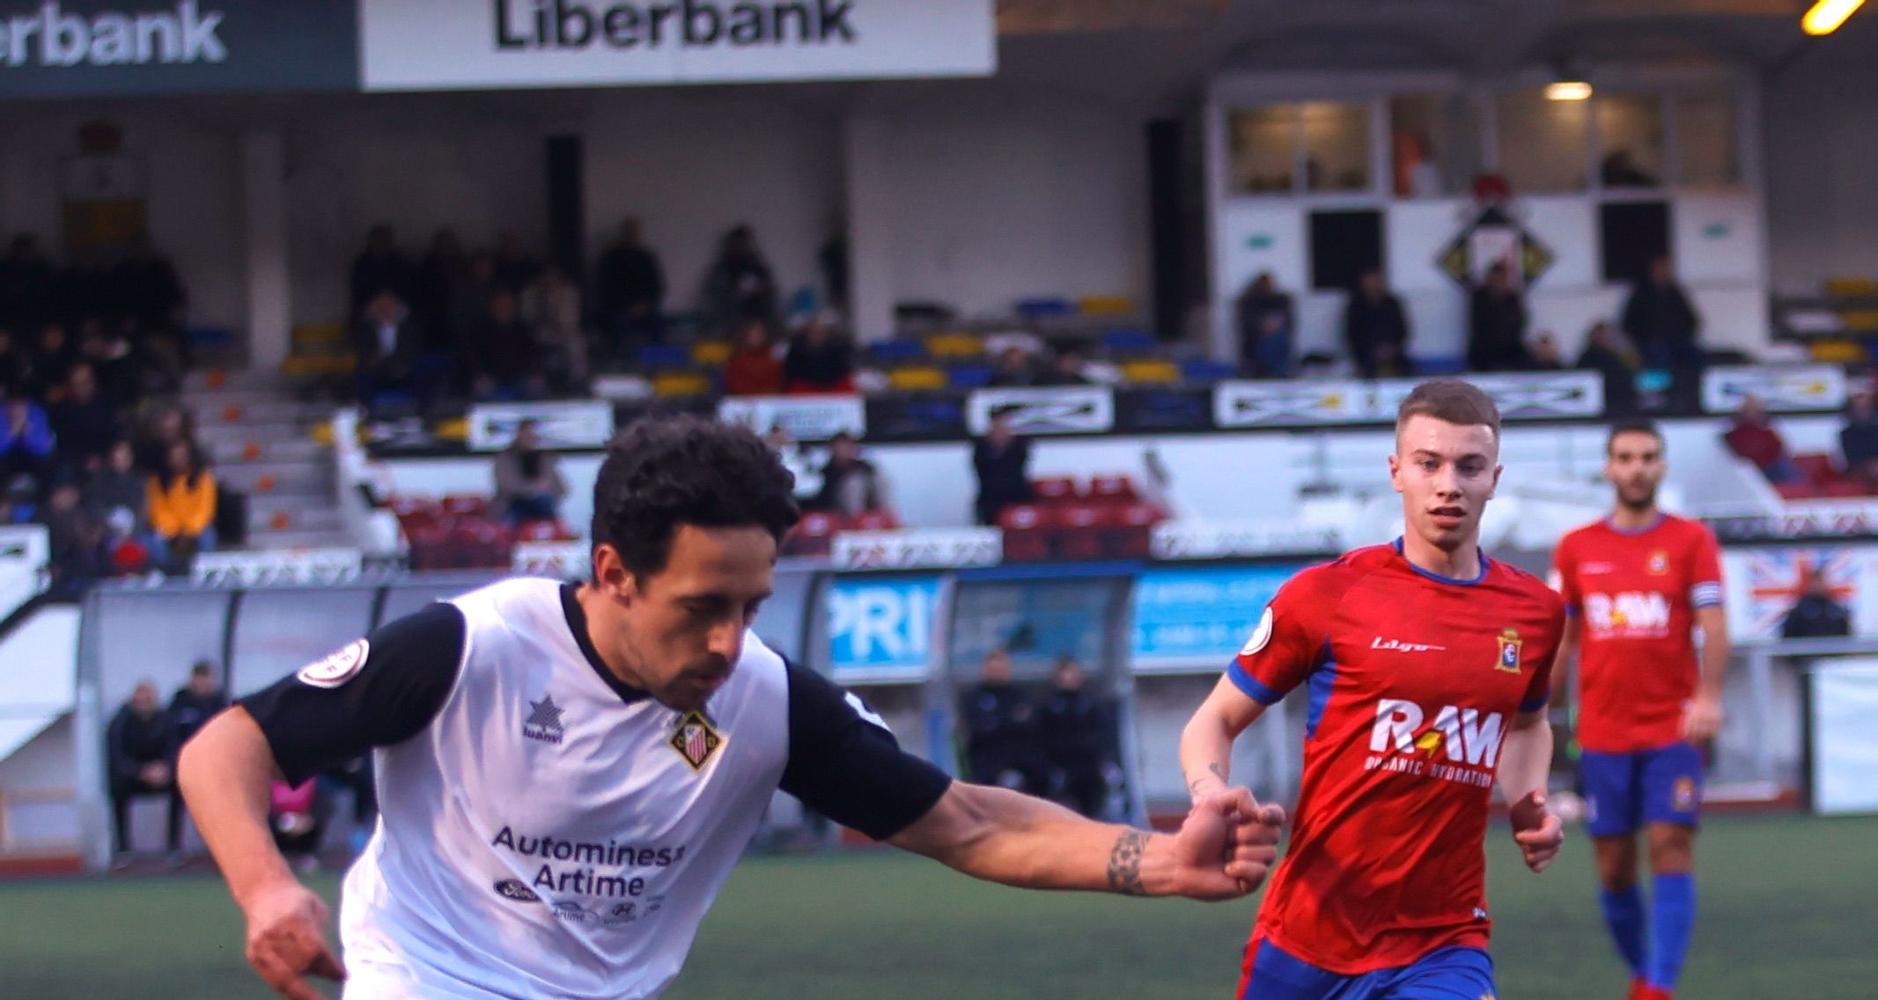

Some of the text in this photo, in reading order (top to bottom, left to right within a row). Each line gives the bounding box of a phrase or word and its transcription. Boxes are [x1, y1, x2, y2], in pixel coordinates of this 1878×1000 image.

[493, 0, 857, 50] Liberbank
[1370, 698, 1502, 768] RAW
[533, 864, 645, 897] Artime
